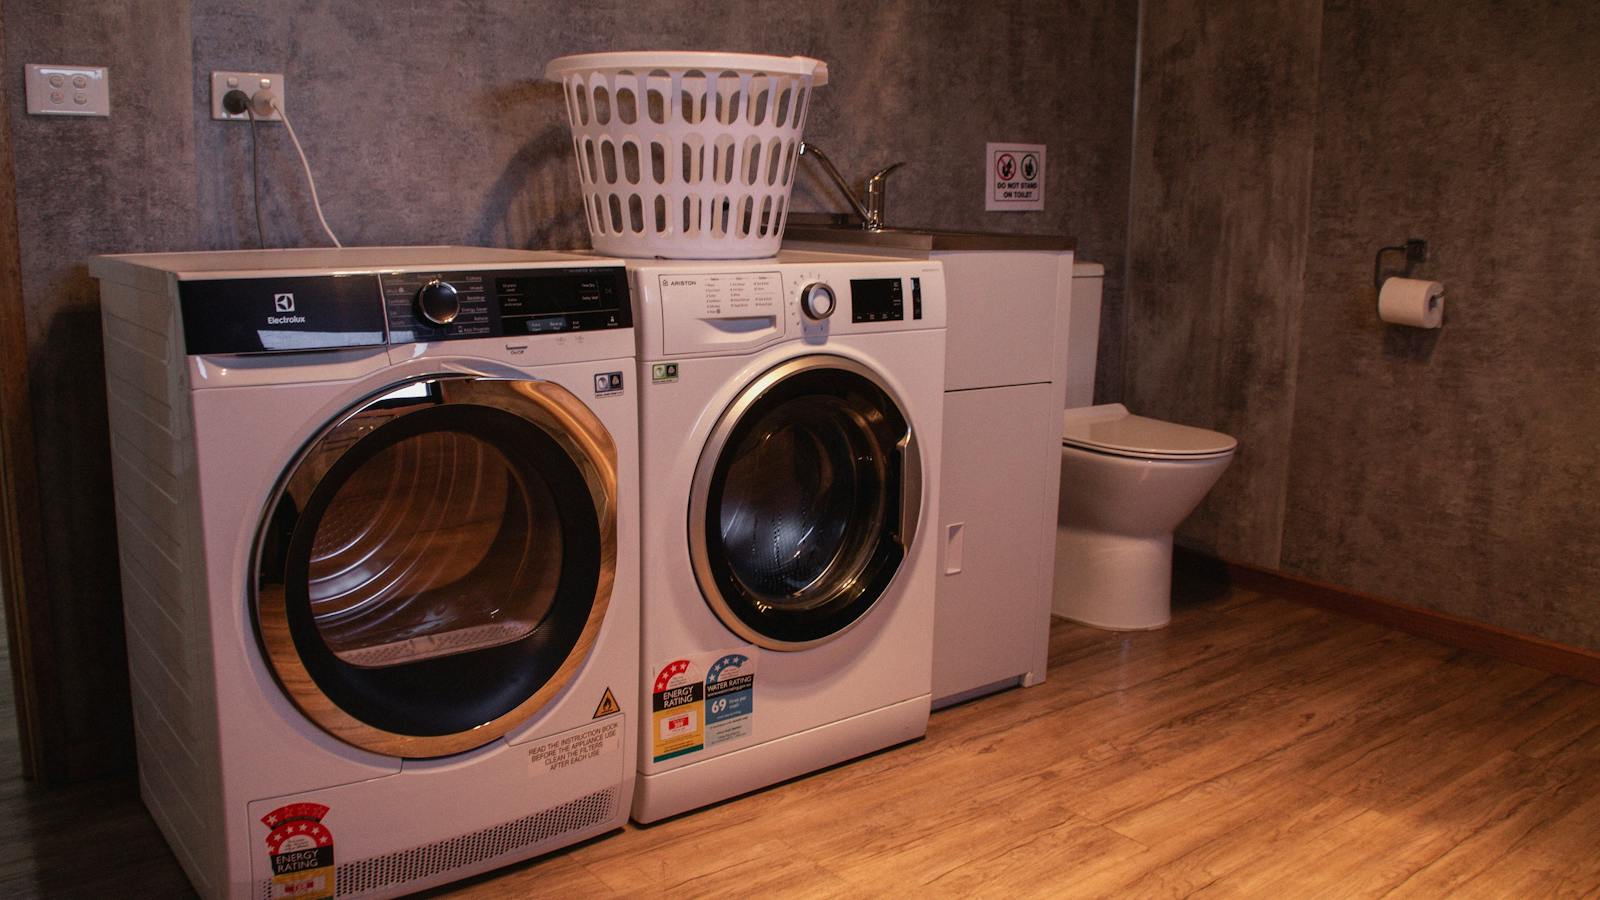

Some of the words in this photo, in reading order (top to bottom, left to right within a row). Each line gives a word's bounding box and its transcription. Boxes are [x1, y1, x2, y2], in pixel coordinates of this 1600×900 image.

[267, 316, 306, 324] Electrolux
[707, 681, 728, 692] WATER
[728, 676, 752, 688] RATING
[663, 686, 694, 700] ENERGY
[663, 695, 693, 709] RATING
[711, 699, 727, 713] 69
[529, 745, 546, 756] READ
[548, 741, 559, 749] THE
[560, 729, 601, 745] INSTRUCTION
[602, 723, 618, 732] BOOK
[531, 750, 557, 762] BEFORE
[559, 746, 570, 754] THE
[571, 735, 603, 749] APPLIANCE
[604, 729, 616, 738] USE
[545, 754, 566, 766] CLEAN
[567, 750, 578, 758] THE
[579, 742, 603, 754] FILTERS
[550, 760, 570, 770] AFTER
[571, 755, 587, 765] EACH
[588, 750, 600, 758] USE
[276, 849, 319, 864] ENERGY
[277, 859, 319, 873] RATING
